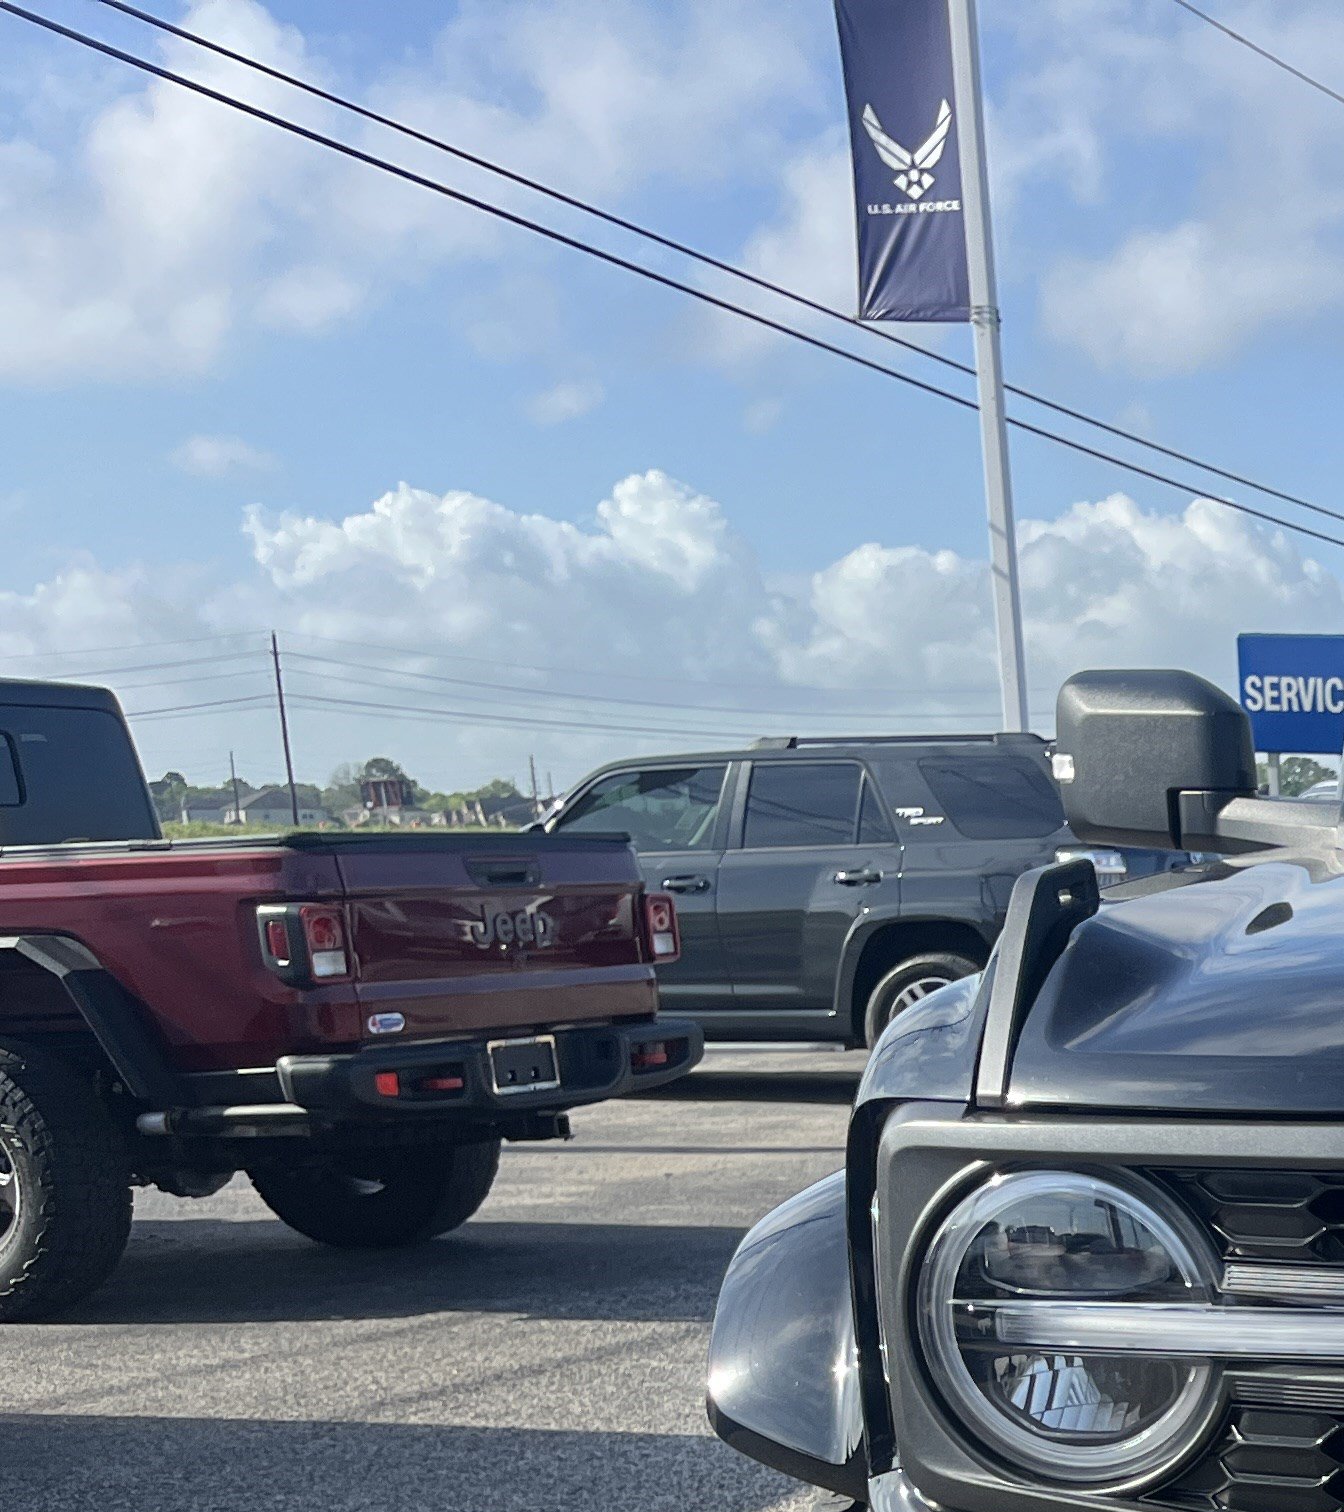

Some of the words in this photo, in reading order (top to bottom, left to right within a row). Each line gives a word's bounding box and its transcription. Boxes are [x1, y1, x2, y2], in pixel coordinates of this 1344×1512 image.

[867, 203, 893, 215] U.S.
[895, 203, 917, 214] AIR
[919, 200, 961, 213] FORCE
[471, 904, 555, 949] Jeep
